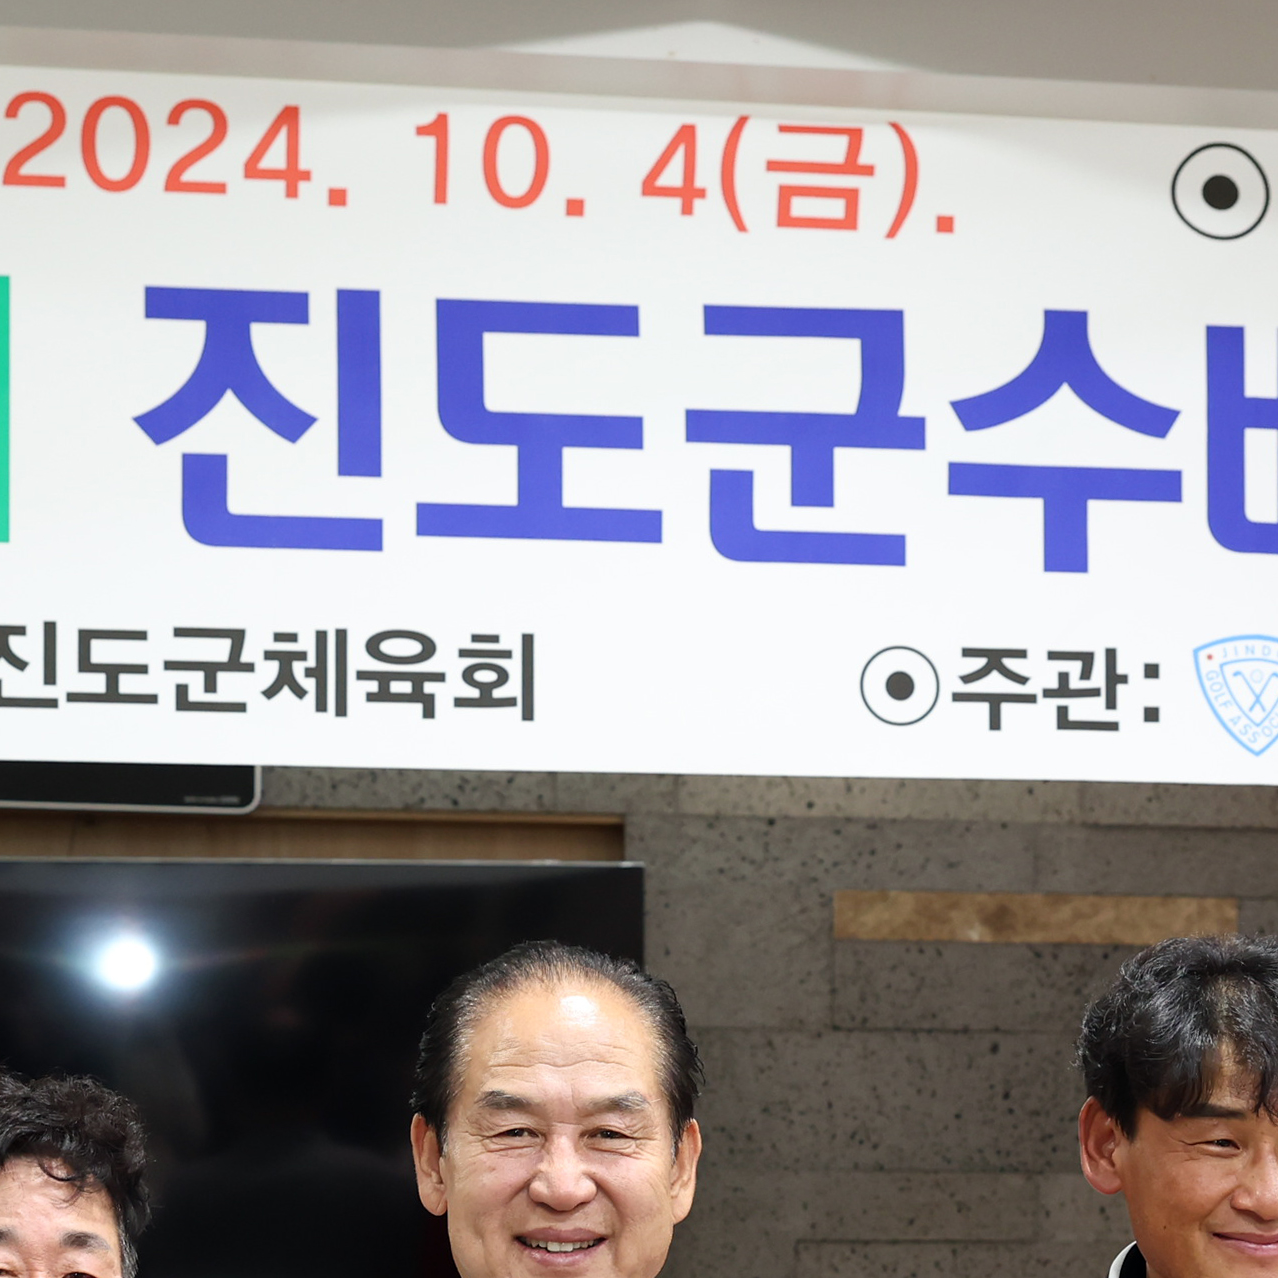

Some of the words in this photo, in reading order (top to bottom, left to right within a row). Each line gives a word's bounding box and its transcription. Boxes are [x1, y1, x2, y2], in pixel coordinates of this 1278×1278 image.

[4, 92, 347, 206] 2024.
[417, 113, 584, 216] 10.
[643, 116, 954, 238] 4(금).
[953, 649, 1158, 730] 주관:
